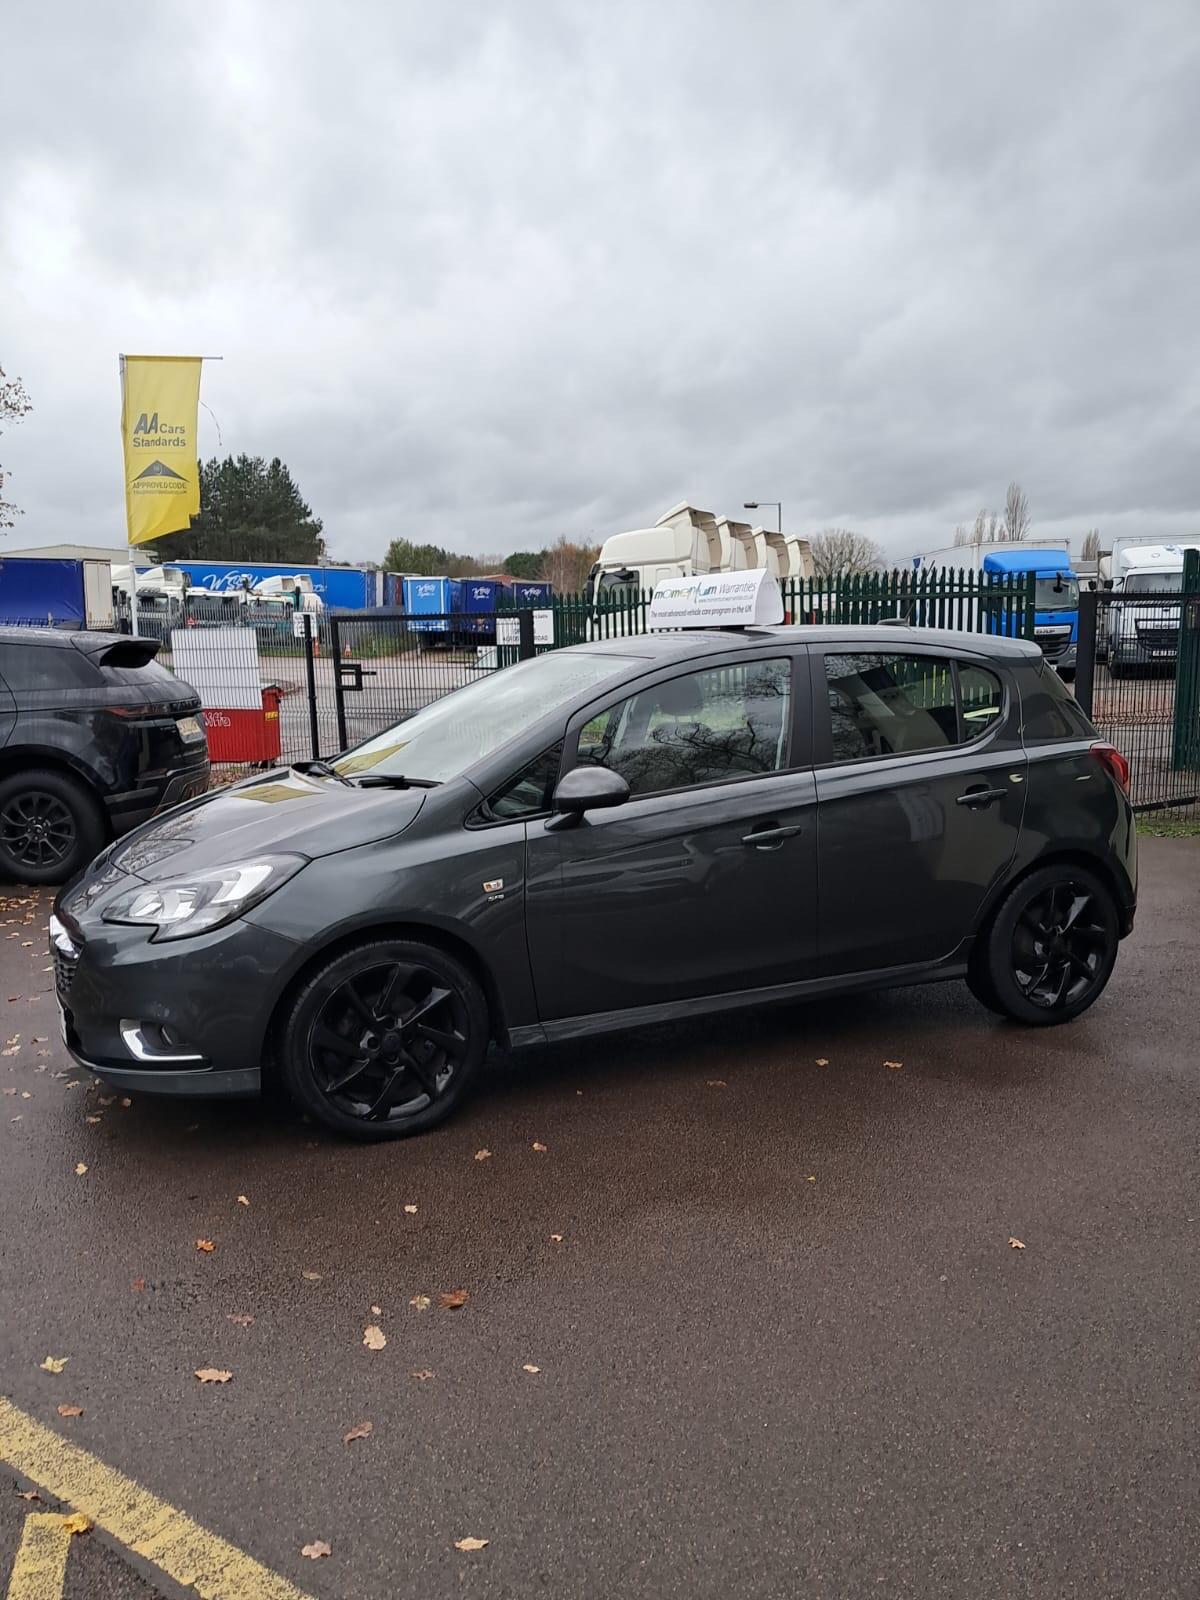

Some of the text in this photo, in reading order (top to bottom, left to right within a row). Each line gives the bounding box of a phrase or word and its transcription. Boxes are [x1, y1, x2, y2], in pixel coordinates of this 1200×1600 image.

[133, 412, 186, 434] AA Cars
[133, 436, 186, 448] Standards
[132, 481, 187, 489] APPROVED CODE
[719, 582, 757, 594] Warranties
